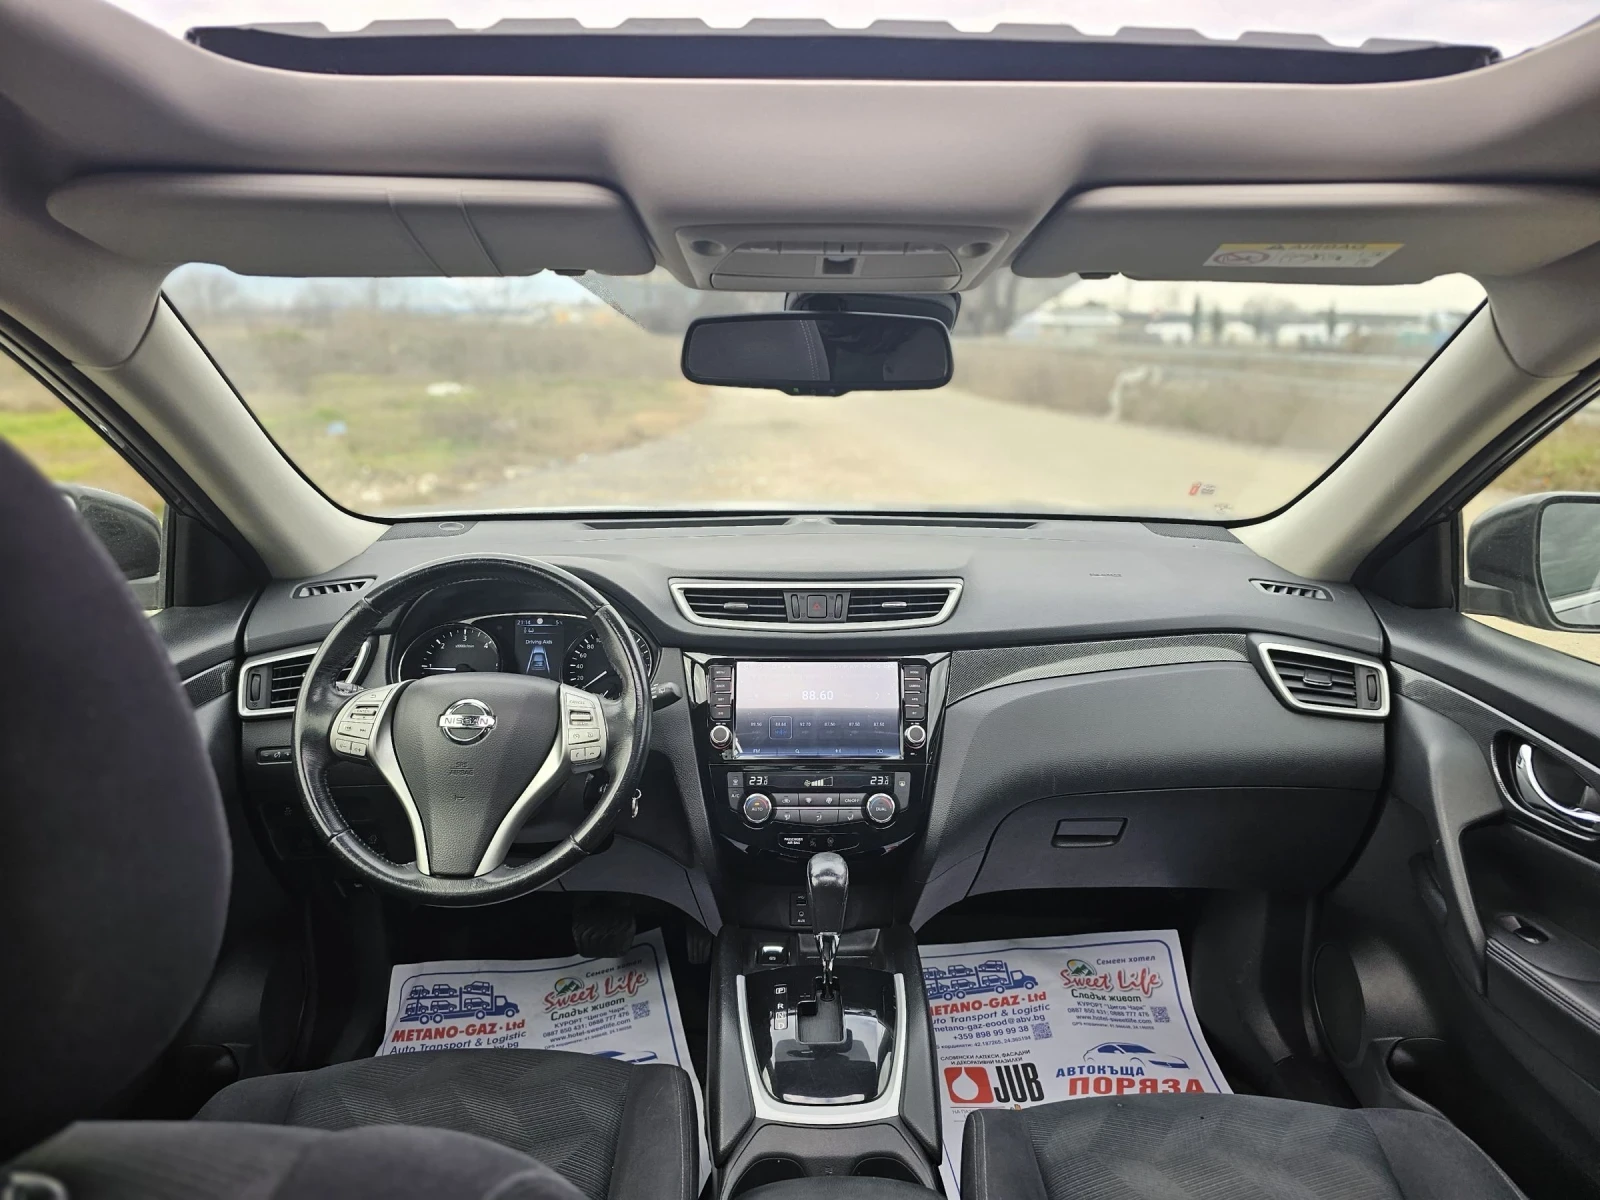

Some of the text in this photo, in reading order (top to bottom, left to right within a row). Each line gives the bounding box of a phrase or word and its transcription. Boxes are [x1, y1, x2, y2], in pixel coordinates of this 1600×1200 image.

[802, 690, 833, 700] 88.60
[444, 717, 489, 725] NISSAN
[543, 970, 646, 1011] Sweet Life
[1060, 968, 1161, 996] Sweet Life
[1027, 991, 1047, 1003] Ltd
[1071, 989, 1106, 1000] Сладък
[550, 997, 625, 1021] Сладък живот
[950, 1011, 998, 1023] Transport
[1012, 1003, 1050, 1016] Logistic
[391, 1019, 526, 1042] METANO-GAZ Ltd
[554, 1018, 582, 1028] КУРОРТ
[933, 1014, 1046, 1033] metano-gaz-eood@abv.bg
[390, 1030, 527, 1055] Auto Transport & Logistic
[953, 1025, 1029, 1041] +359 898 99 99 38
[1002, 1050, 1031, 1058] ФАСАДНИ
[1056, 1065, 1145, 1078] АВТОКЪЩА
[993, 1062, 1045, 1103] JUB
[1069, 1077, 1205, 1096] ПОРЯЗА
